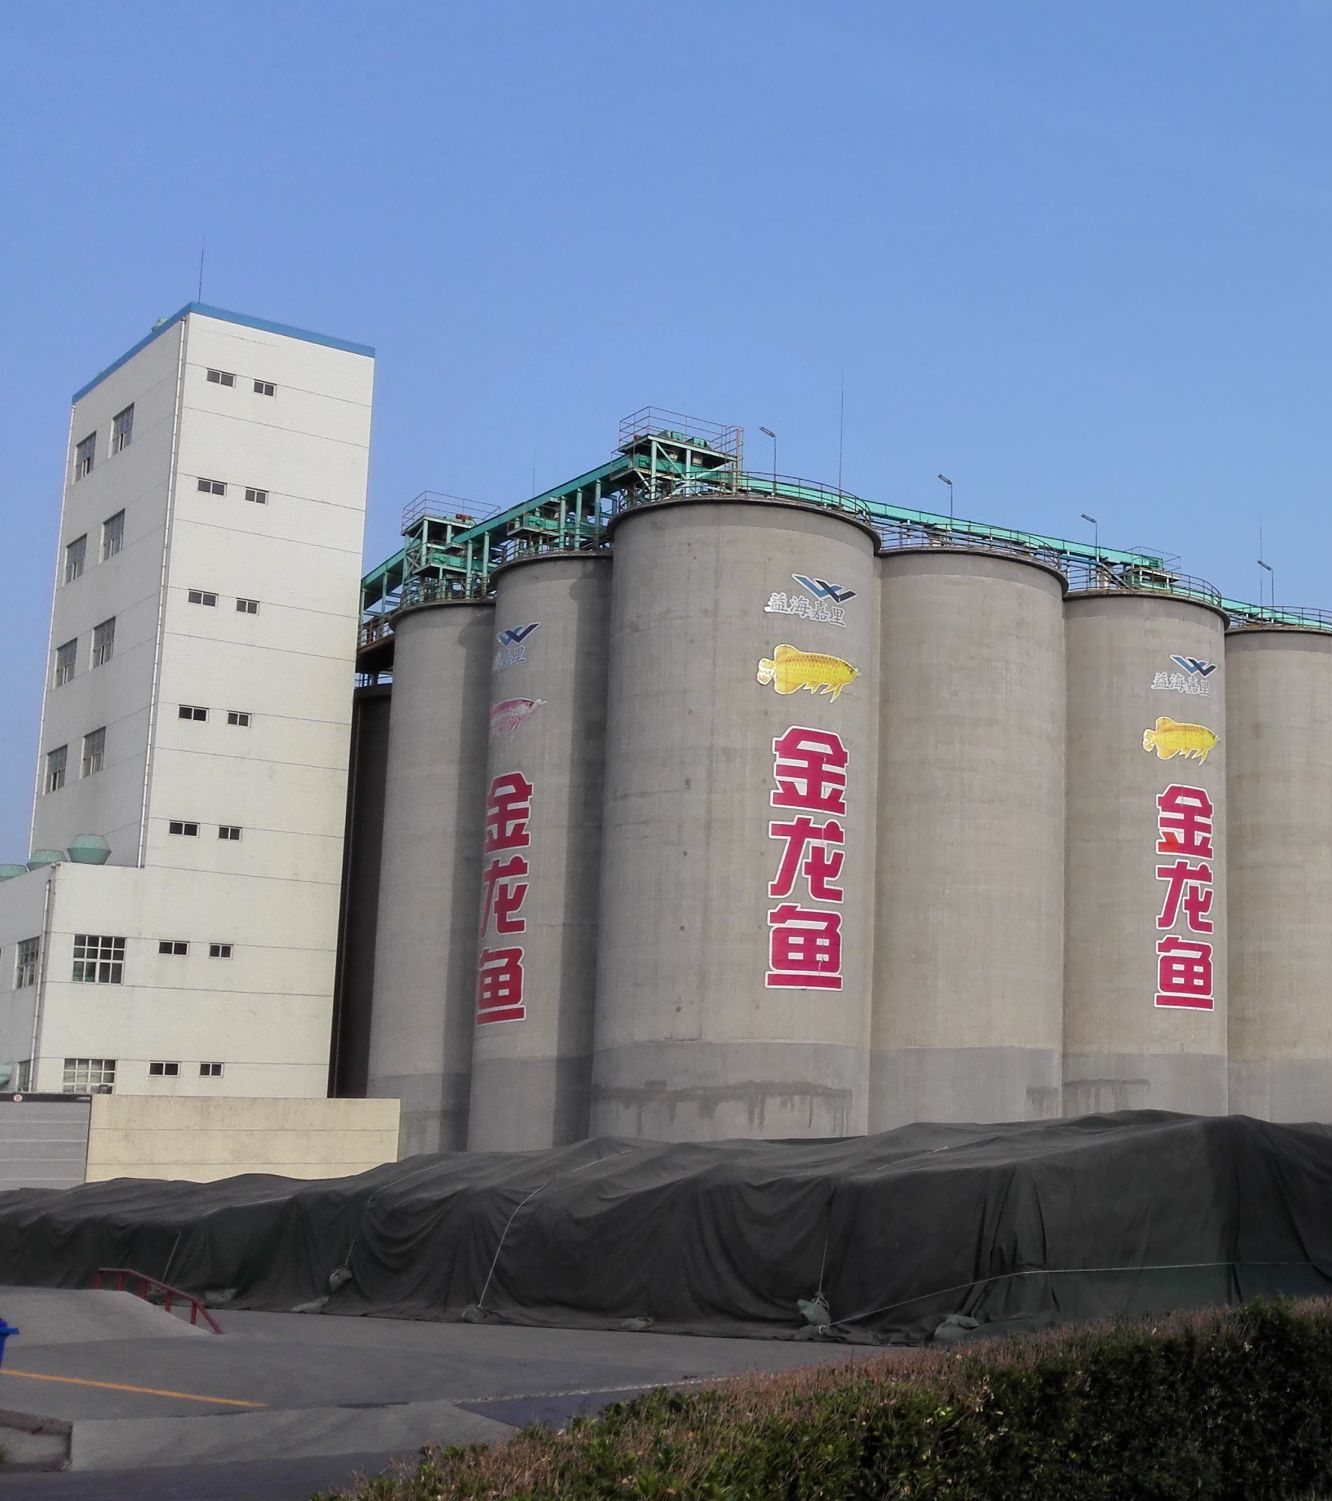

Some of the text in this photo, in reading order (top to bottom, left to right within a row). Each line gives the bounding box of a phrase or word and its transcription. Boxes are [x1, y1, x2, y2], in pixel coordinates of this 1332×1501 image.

[764, 592, 846, 629] 益海嘉里
[476, 772, 534, 1025] 金龙鱼
[765, 726, 849, 991] 金龙鱼
[1153, 783, 1215, 1012] 金龙鱼
